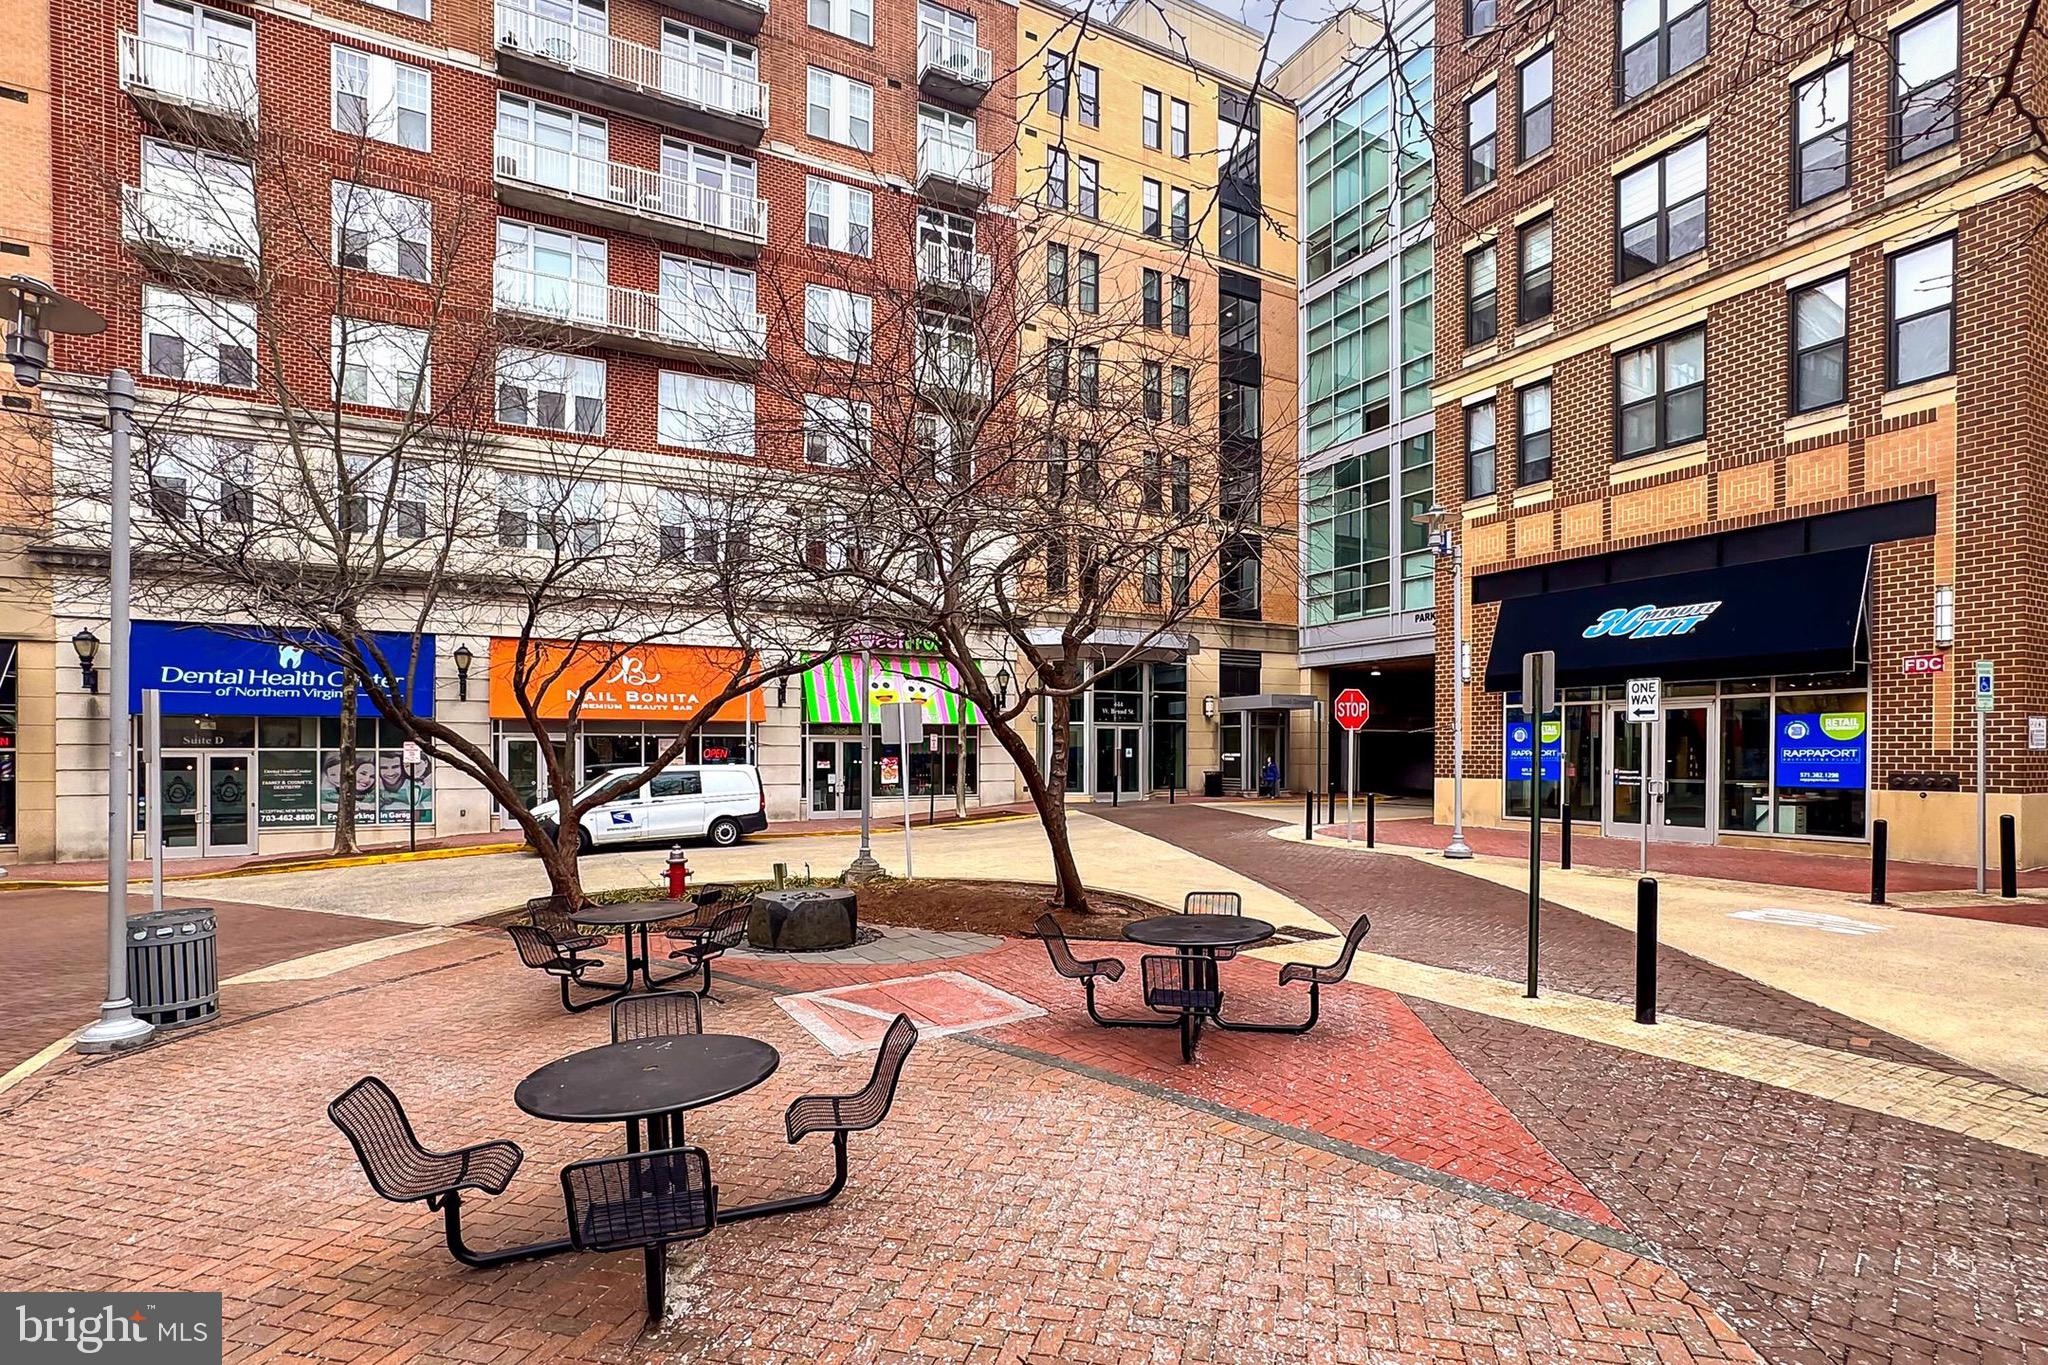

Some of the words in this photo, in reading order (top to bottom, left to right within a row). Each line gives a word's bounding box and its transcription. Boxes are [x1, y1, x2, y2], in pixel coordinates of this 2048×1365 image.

[1582, 604, 1656, 638] 30
[1640, 600, 1722, 621] MINUTE
[1628, 614, 1709, 639] HIT
[1904, 657, 1942, 671] FDC
[161, 666, 244, 685] Dental
[248, 668, 324, 686] Health
[215, 686, 233, 696] of
[235, 687, 300, 697] Northern
[1631, 682, 1656, 693] ONE
[567, 689, 617, 701] NAIL
[625, 690, 700, 703] BONITA
[1631, 694, 1657, 705] WAY
[629, 703, 668, 711] BEAUTY
[1337, 702, 1367, 717] STOP
[1825, 717, 1859, 726] RETAIL
[183, 735, 212, 745] Suite
[214, 736, 224, 745] D
[703, 748, 728, 759] OPEN
[1783, 749, 1858, 758] RAPPAPORT
